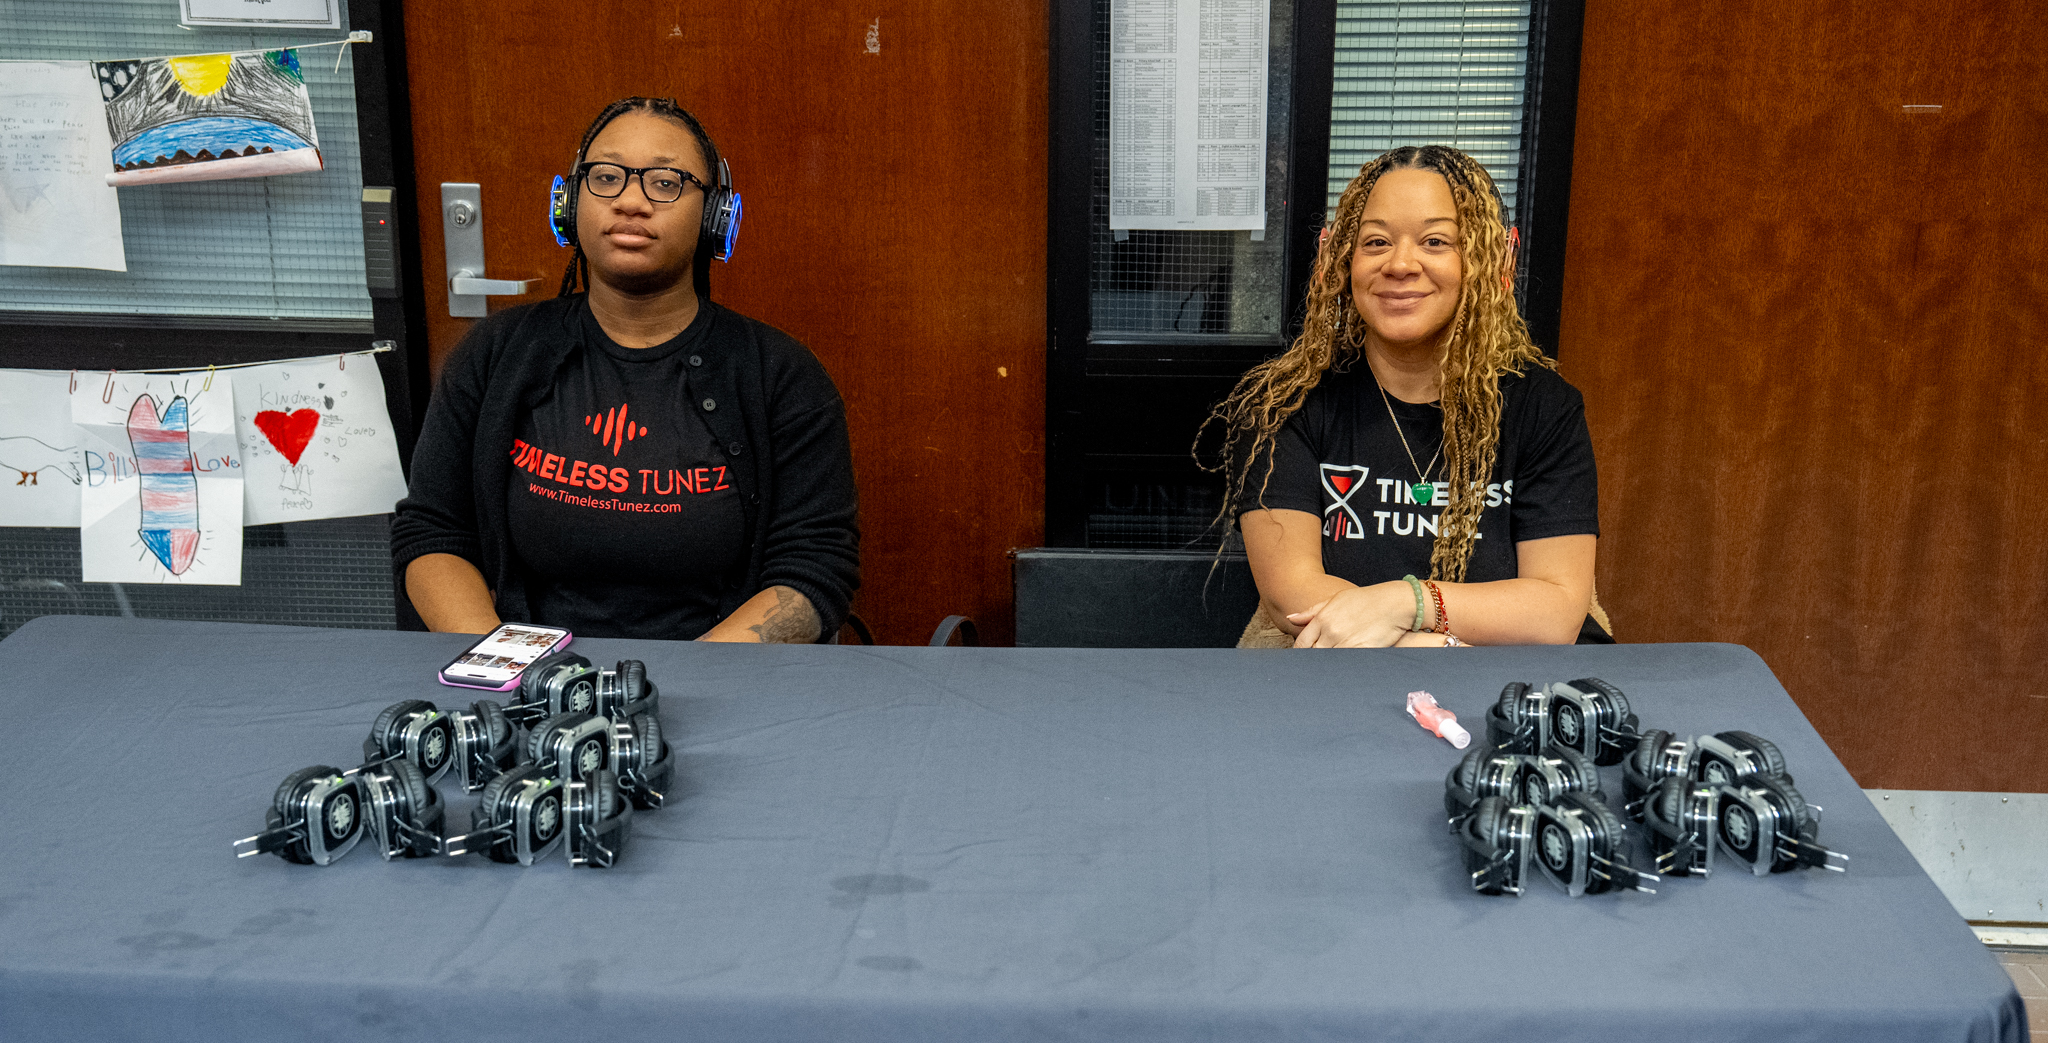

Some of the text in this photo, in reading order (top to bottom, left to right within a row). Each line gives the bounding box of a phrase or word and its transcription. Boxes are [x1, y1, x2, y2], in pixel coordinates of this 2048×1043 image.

[509, 438, 730, 495] TIMELESS TUNEZ
[529, 482, 682, 513] www.TimelessTunez.com
